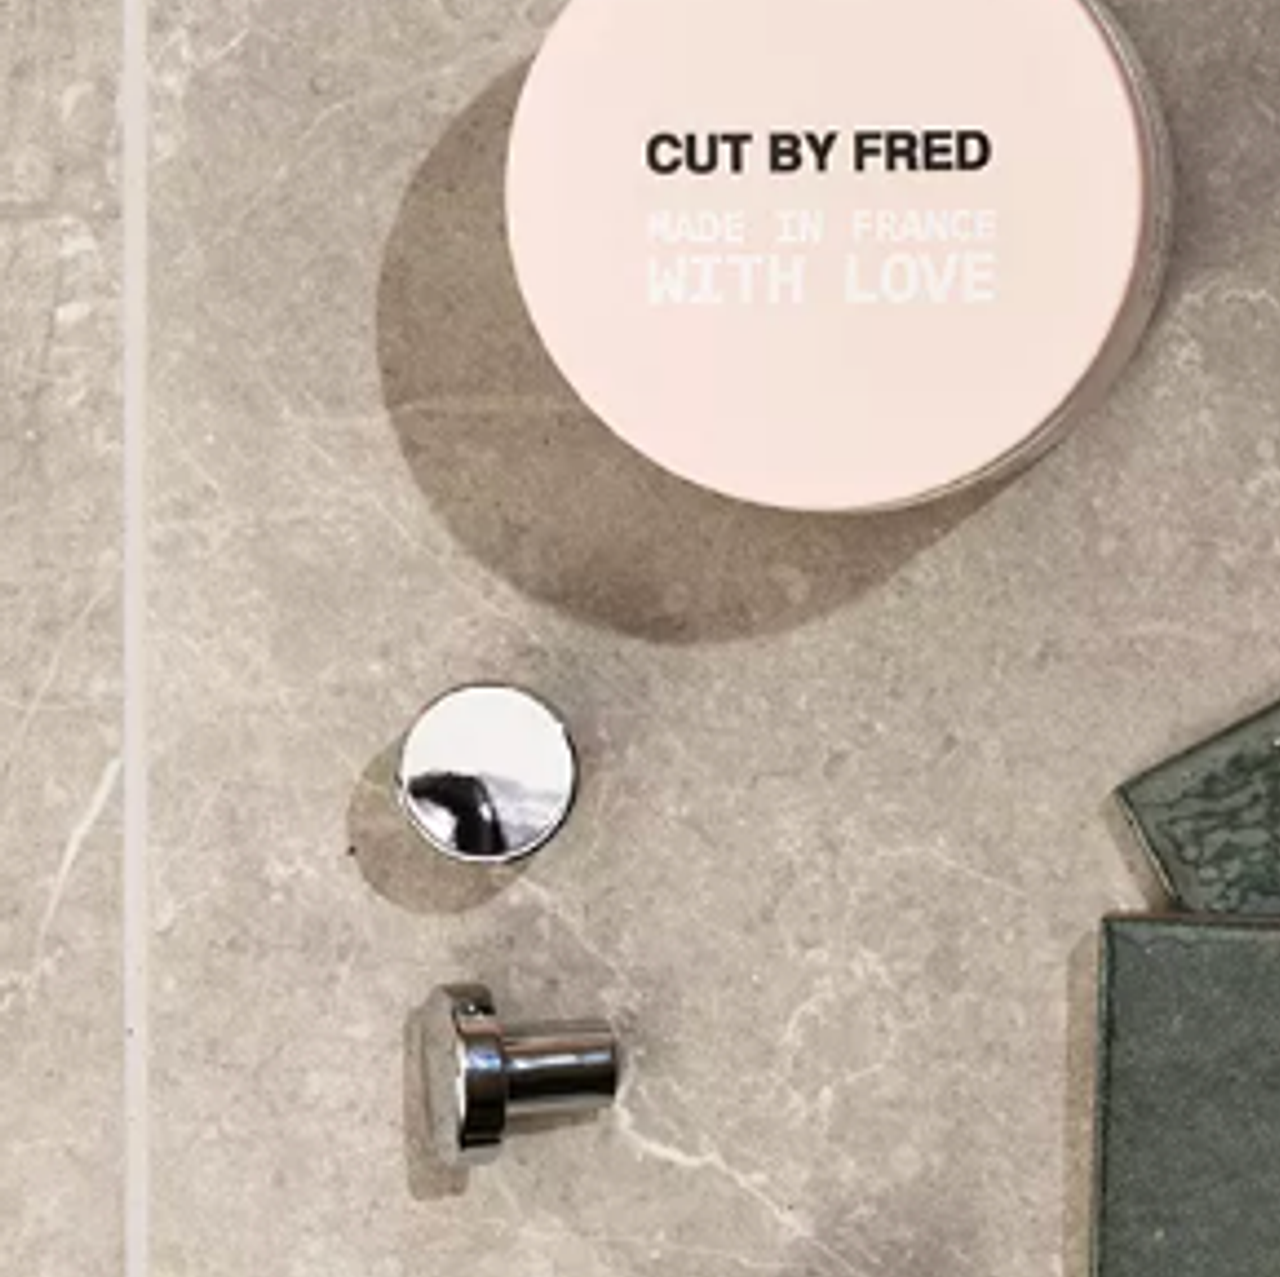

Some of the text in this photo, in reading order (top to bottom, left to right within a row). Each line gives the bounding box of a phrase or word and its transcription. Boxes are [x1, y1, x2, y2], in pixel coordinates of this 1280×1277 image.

[646, 130, 992, 173] CUT BY FRED
[648, 207, 997, 243] MADE IN FRANCE
[648, 251, 997, 304] WITH LOVE
